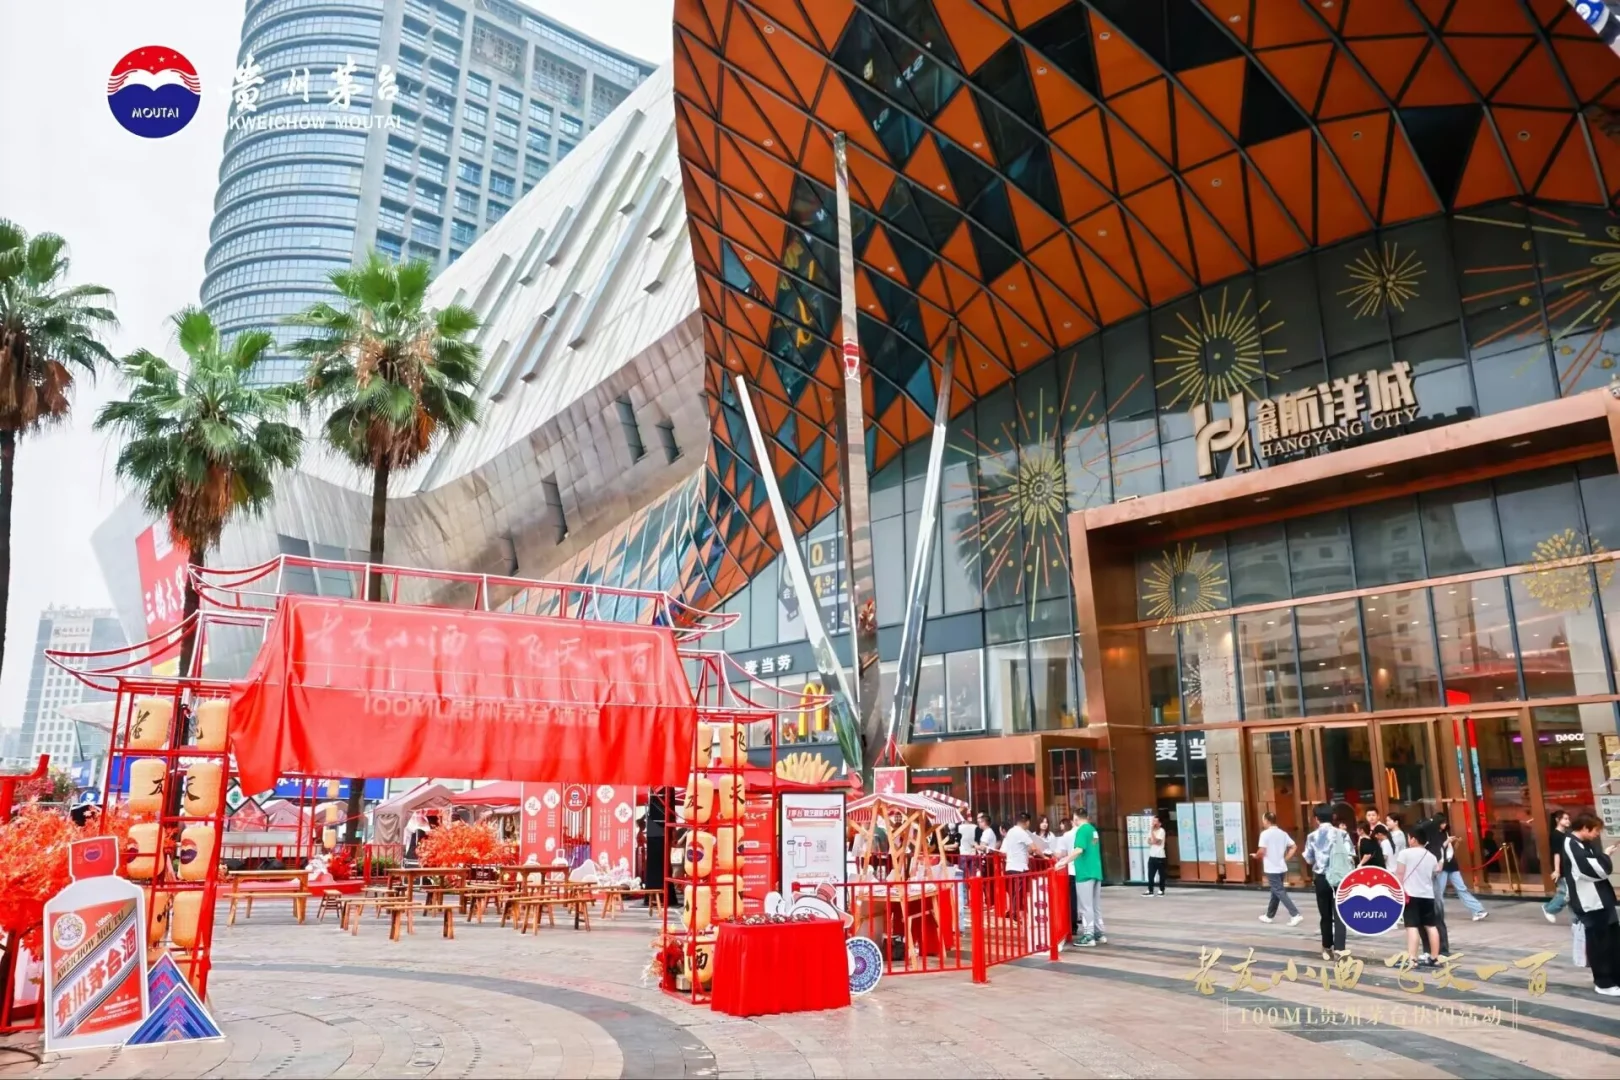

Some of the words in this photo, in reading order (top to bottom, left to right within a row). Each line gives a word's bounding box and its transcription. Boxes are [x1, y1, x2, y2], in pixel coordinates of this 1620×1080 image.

[1261, 421, 1364, 458] HANGYANG
[1371, 405, 1419, 431] CITY
[744, 654, 792, 675] 麦当劳
[96, 909, 124, 942] MOUTAI
[55, 923, 136, 1028] 贵州茅台酒
